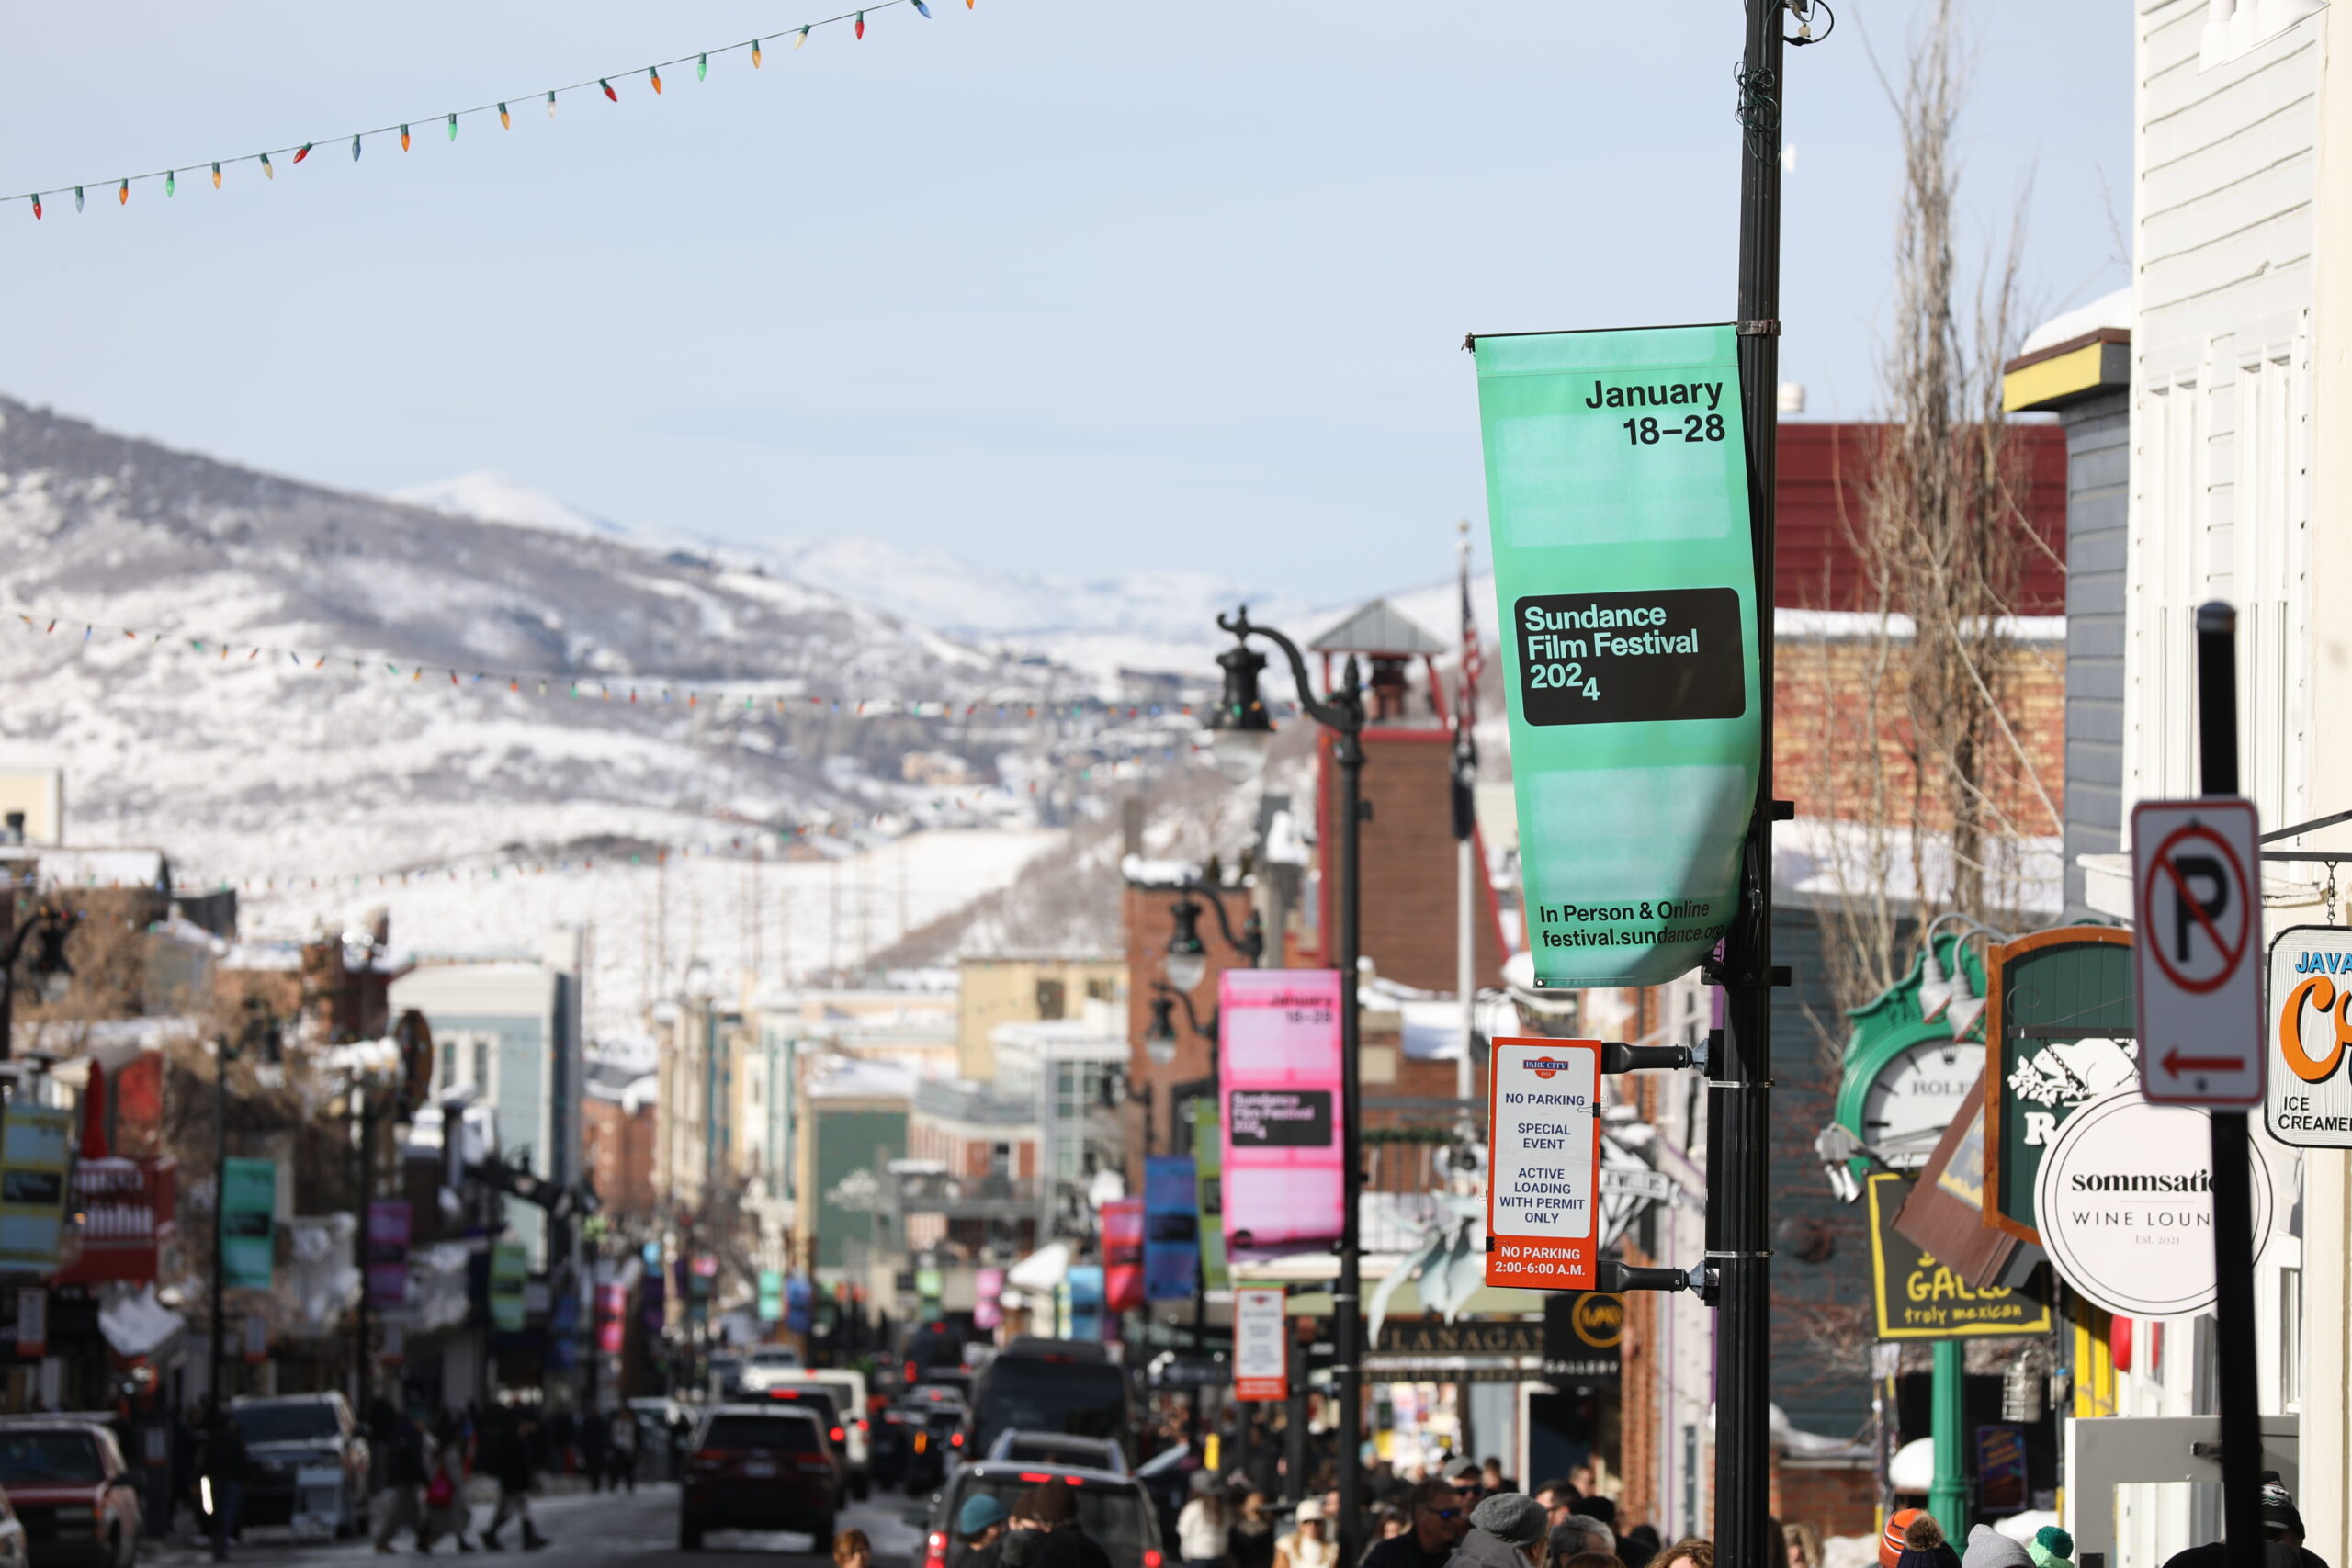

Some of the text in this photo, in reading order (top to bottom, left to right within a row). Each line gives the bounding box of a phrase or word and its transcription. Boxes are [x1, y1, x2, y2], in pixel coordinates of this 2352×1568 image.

[1585, 379, 1724, 409] January
[1623, 412, 1726, 446] 18–28
[1524, 604, 1667, 632] Sundance
[1527, 628, 1699, 660] Film Festival
[1530, 662, 1600, 701] 2024
[1540, 900, 1710, 923] In Person & Online
[1542, 923, 1725, 947] festival.sundance.org
[1505, 1092, 1585, 1106] NO PARKING
[2284, 1096, 2310, 1111] ICE
[1517, 1122, 1571, 1135] SPECIAL
[2278, 1114, 2352, 1132] CREAME
[1523, 1138, 1565, 1149] EVENT
[1518, 1168, 1566, 1179] ACTIVE
[2072, 1169, 2214, 1192] sommsati
[1514, 1181, 1571, 1194] LOADING
[1499, 1196, 1585, 1210] WITH PERMIT
[1525, 1213, 1559, 1224] ONLY
[2072, 1211, 2211, 1226] WINE LOUN
[2135, 1234, 2180, 1245] Est. 2021
[1501, 1246, 1580, 1259] NO PARKING
[1495, 1261, 1586, 1276] 2:00-6:00 A.M.
[1905, 1303, 2022, 1325] truly mexican
